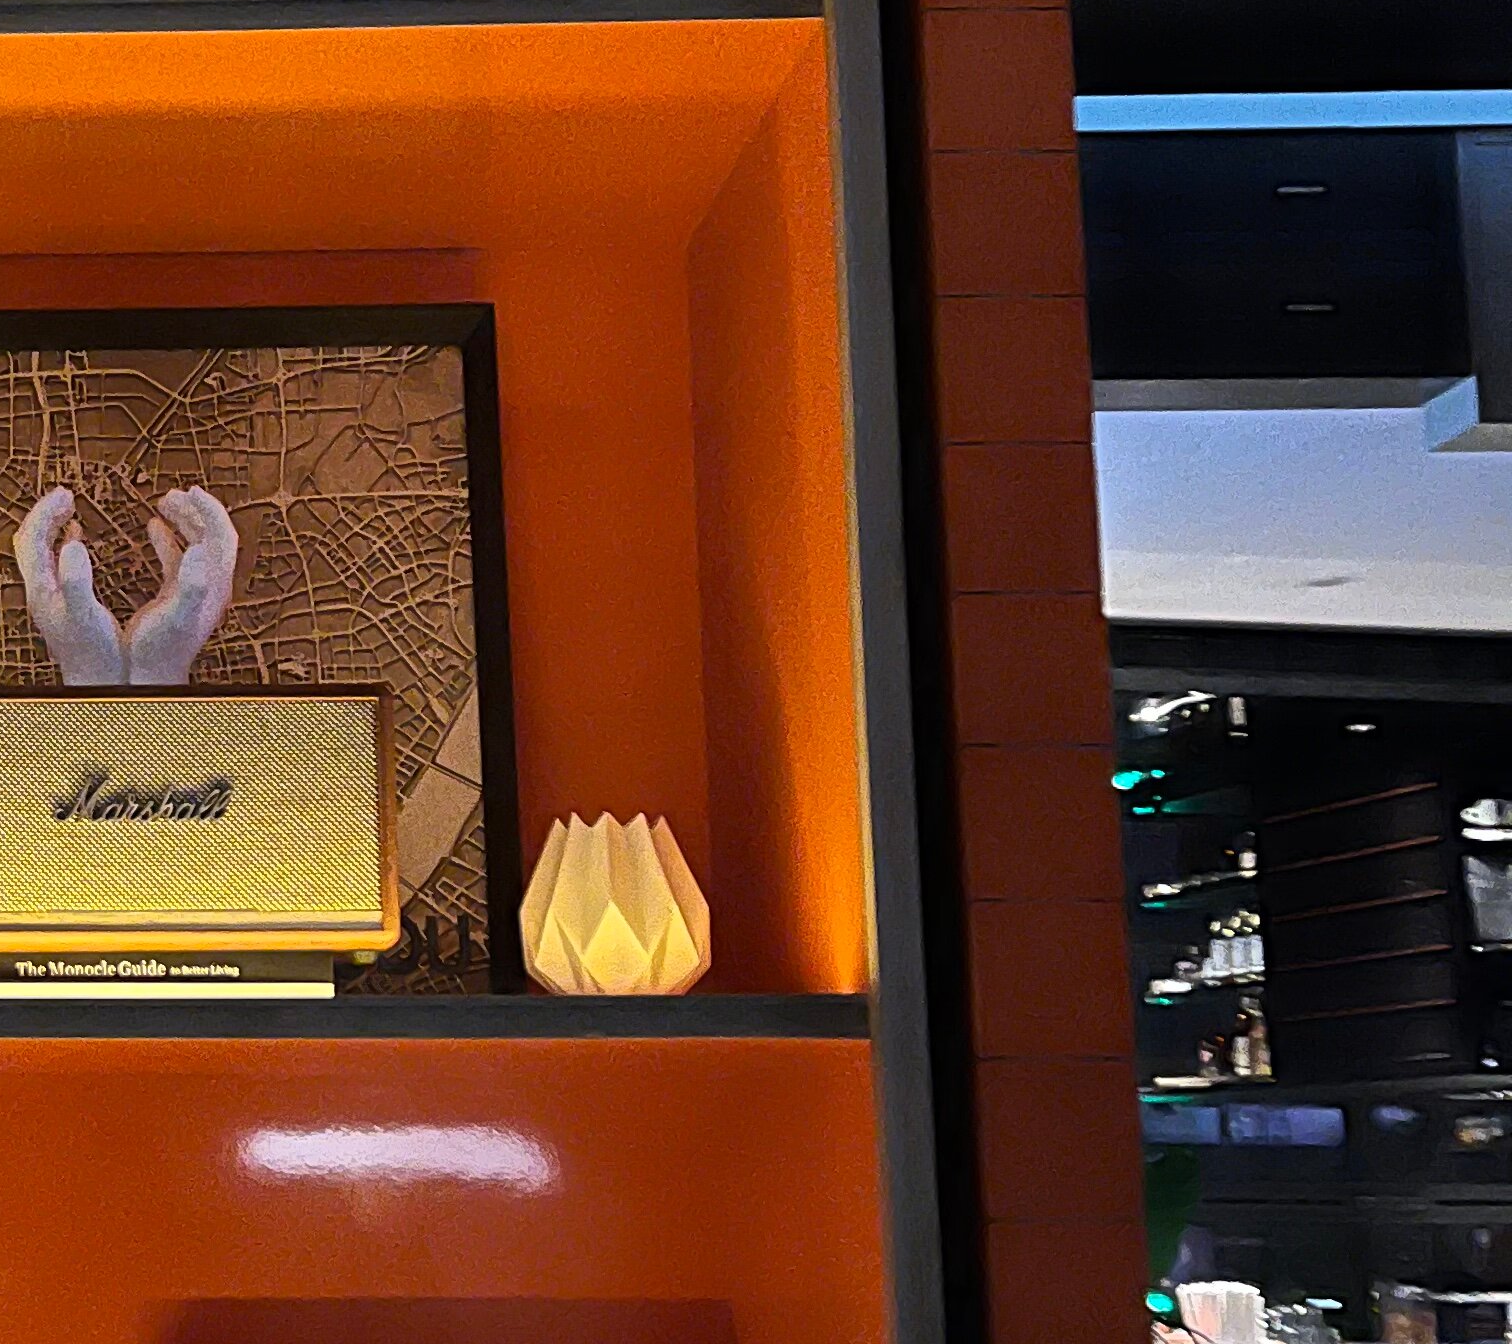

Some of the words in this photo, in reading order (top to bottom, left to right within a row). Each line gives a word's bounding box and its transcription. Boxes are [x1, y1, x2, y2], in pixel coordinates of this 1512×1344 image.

[53, 776, 233, 823] Marshall
[15, 959, 47, 977] The
[48, 959, 117, 977] Monocle
[117, 958, 167, 977] Guide
